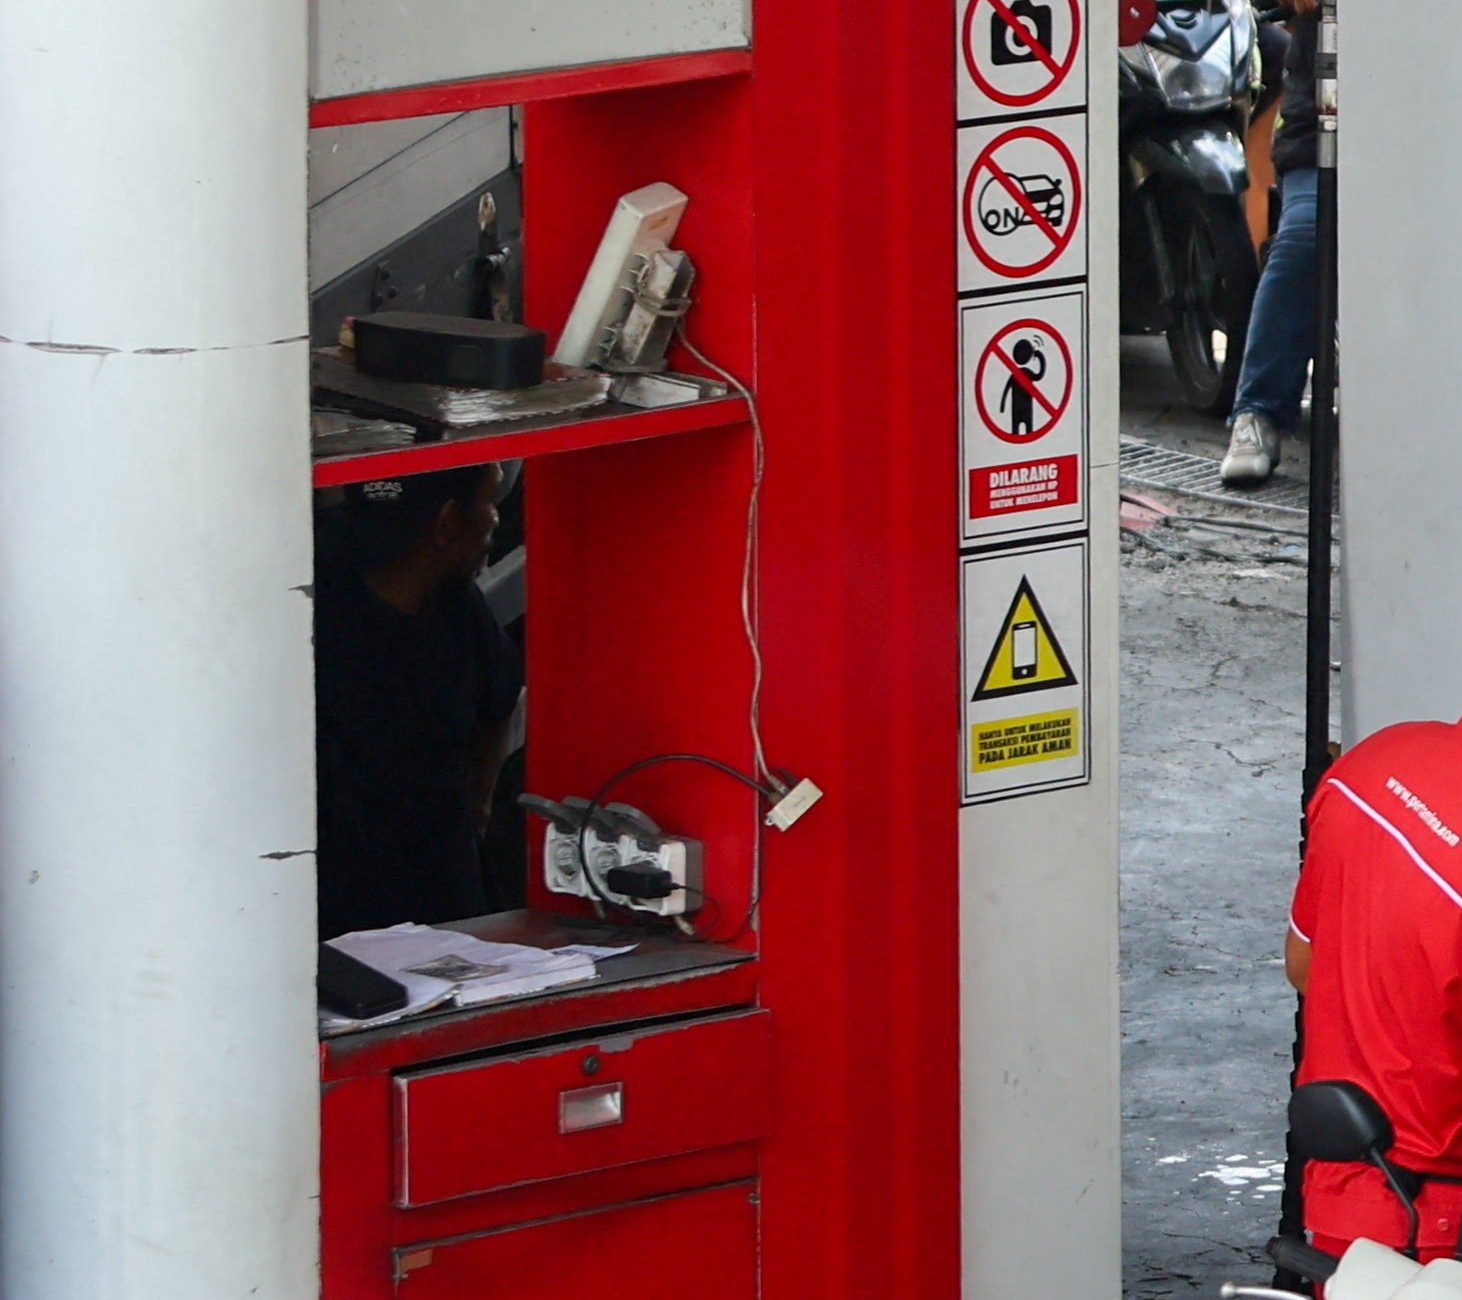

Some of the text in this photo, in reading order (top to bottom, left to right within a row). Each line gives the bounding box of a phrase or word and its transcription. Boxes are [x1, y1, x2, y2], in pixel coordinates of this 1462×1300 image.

[986, 206, 1020, 231] ON
[989, 463, 1058, 488] DILARANG
[979, 729, 1002, 741] HANYA
[979, 736, 1019, 751] TRANSAKSI
[979, 737, 1071, 765] PADA JARAK AMAN
